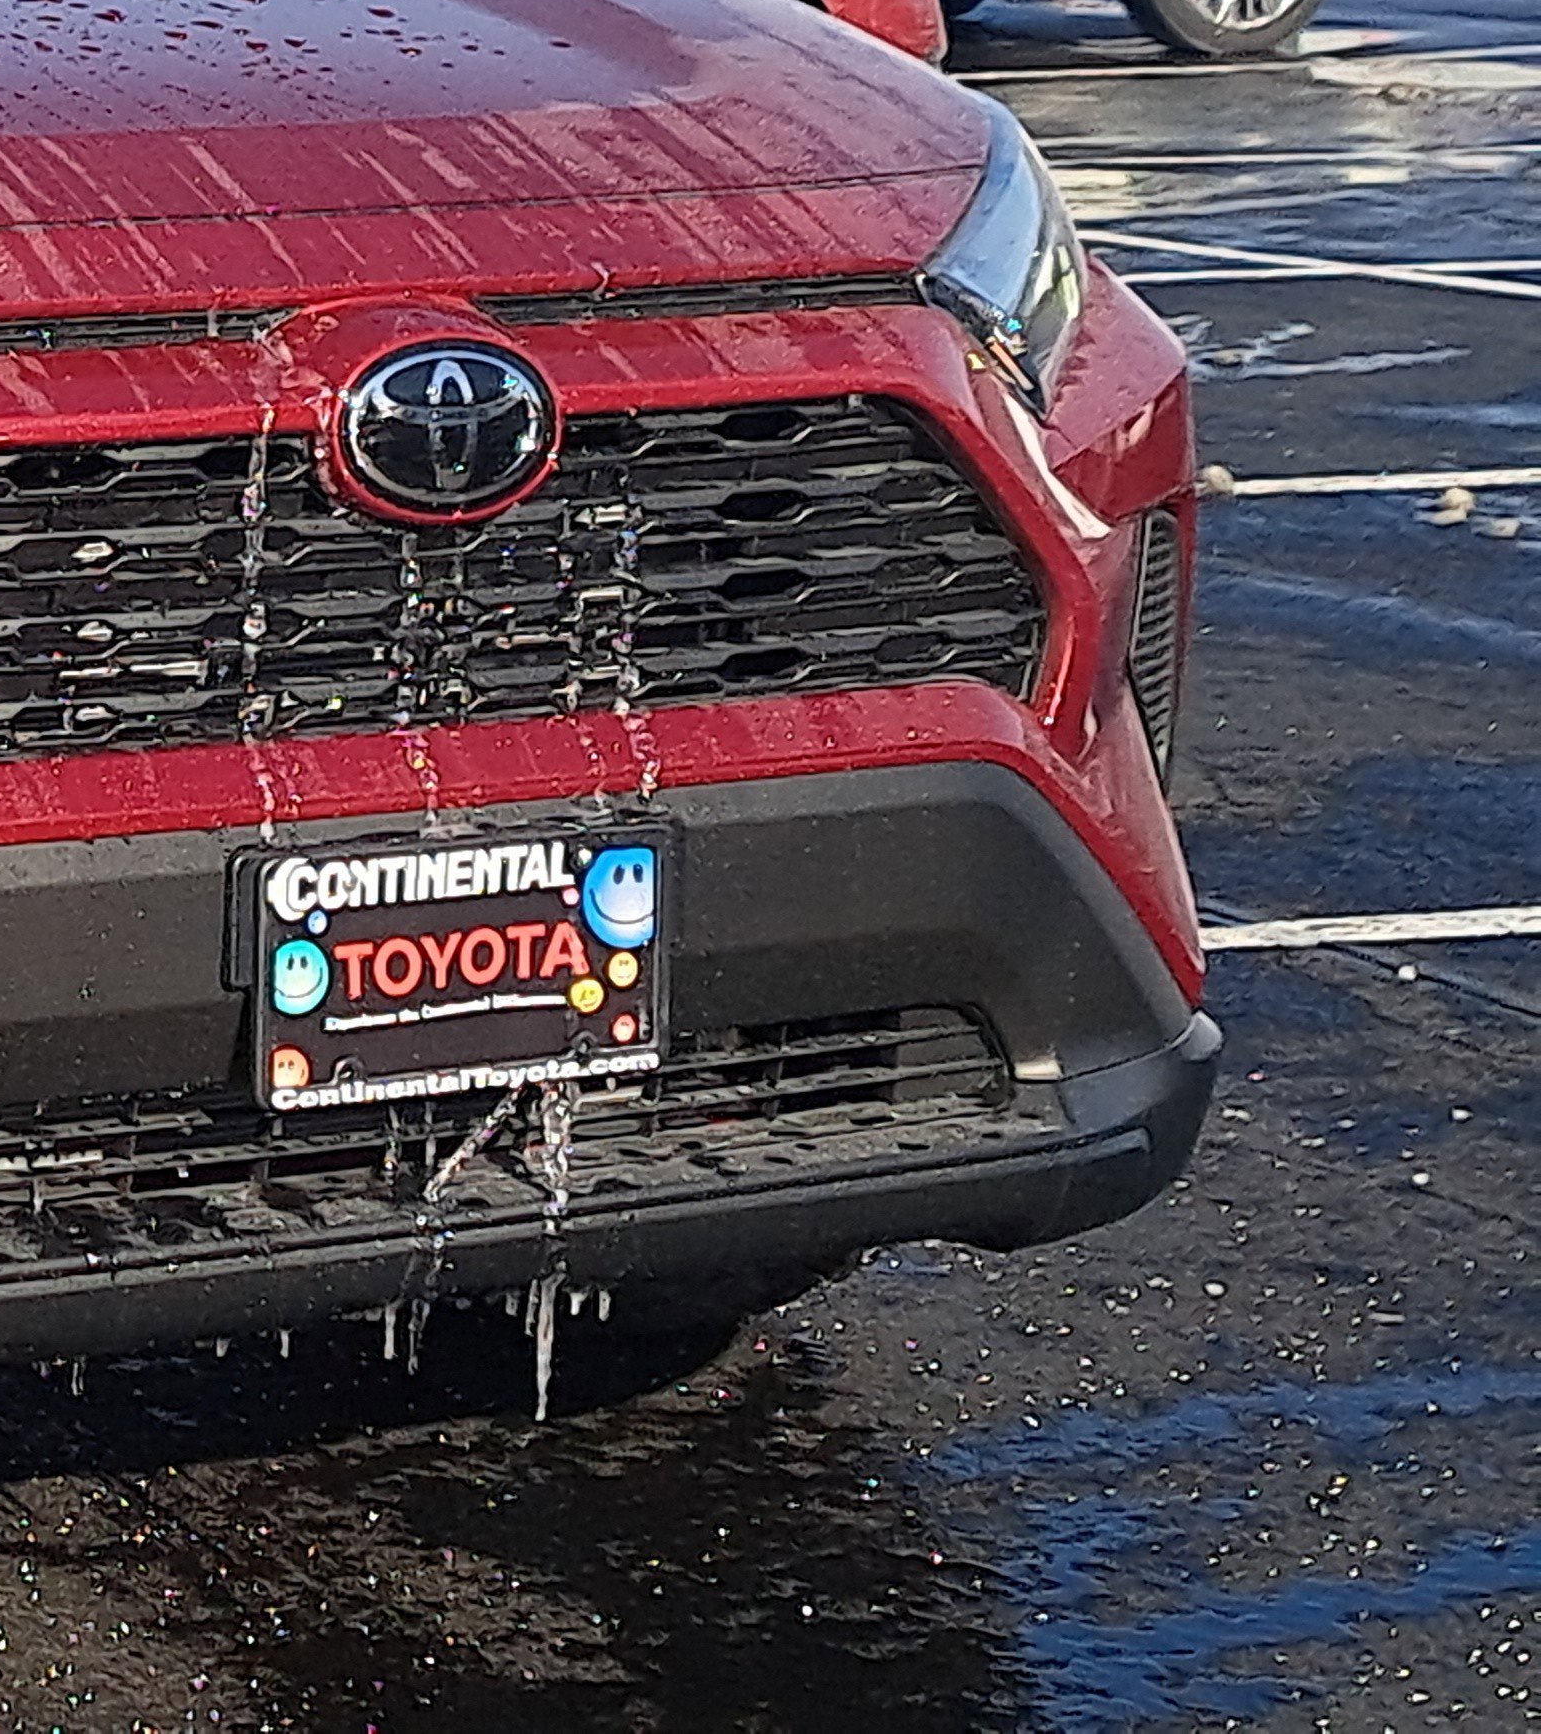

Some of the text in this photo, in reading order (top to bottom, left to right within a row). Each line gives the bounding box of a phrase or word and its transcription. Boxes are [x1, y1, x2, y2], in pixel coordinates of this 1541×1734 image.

[267, 841, 576, 921] CONTINENTAL
[333, 920, 591, 1001] TOYOTA
[271, 1051, 660, 1110] ContinentalToyota.com
